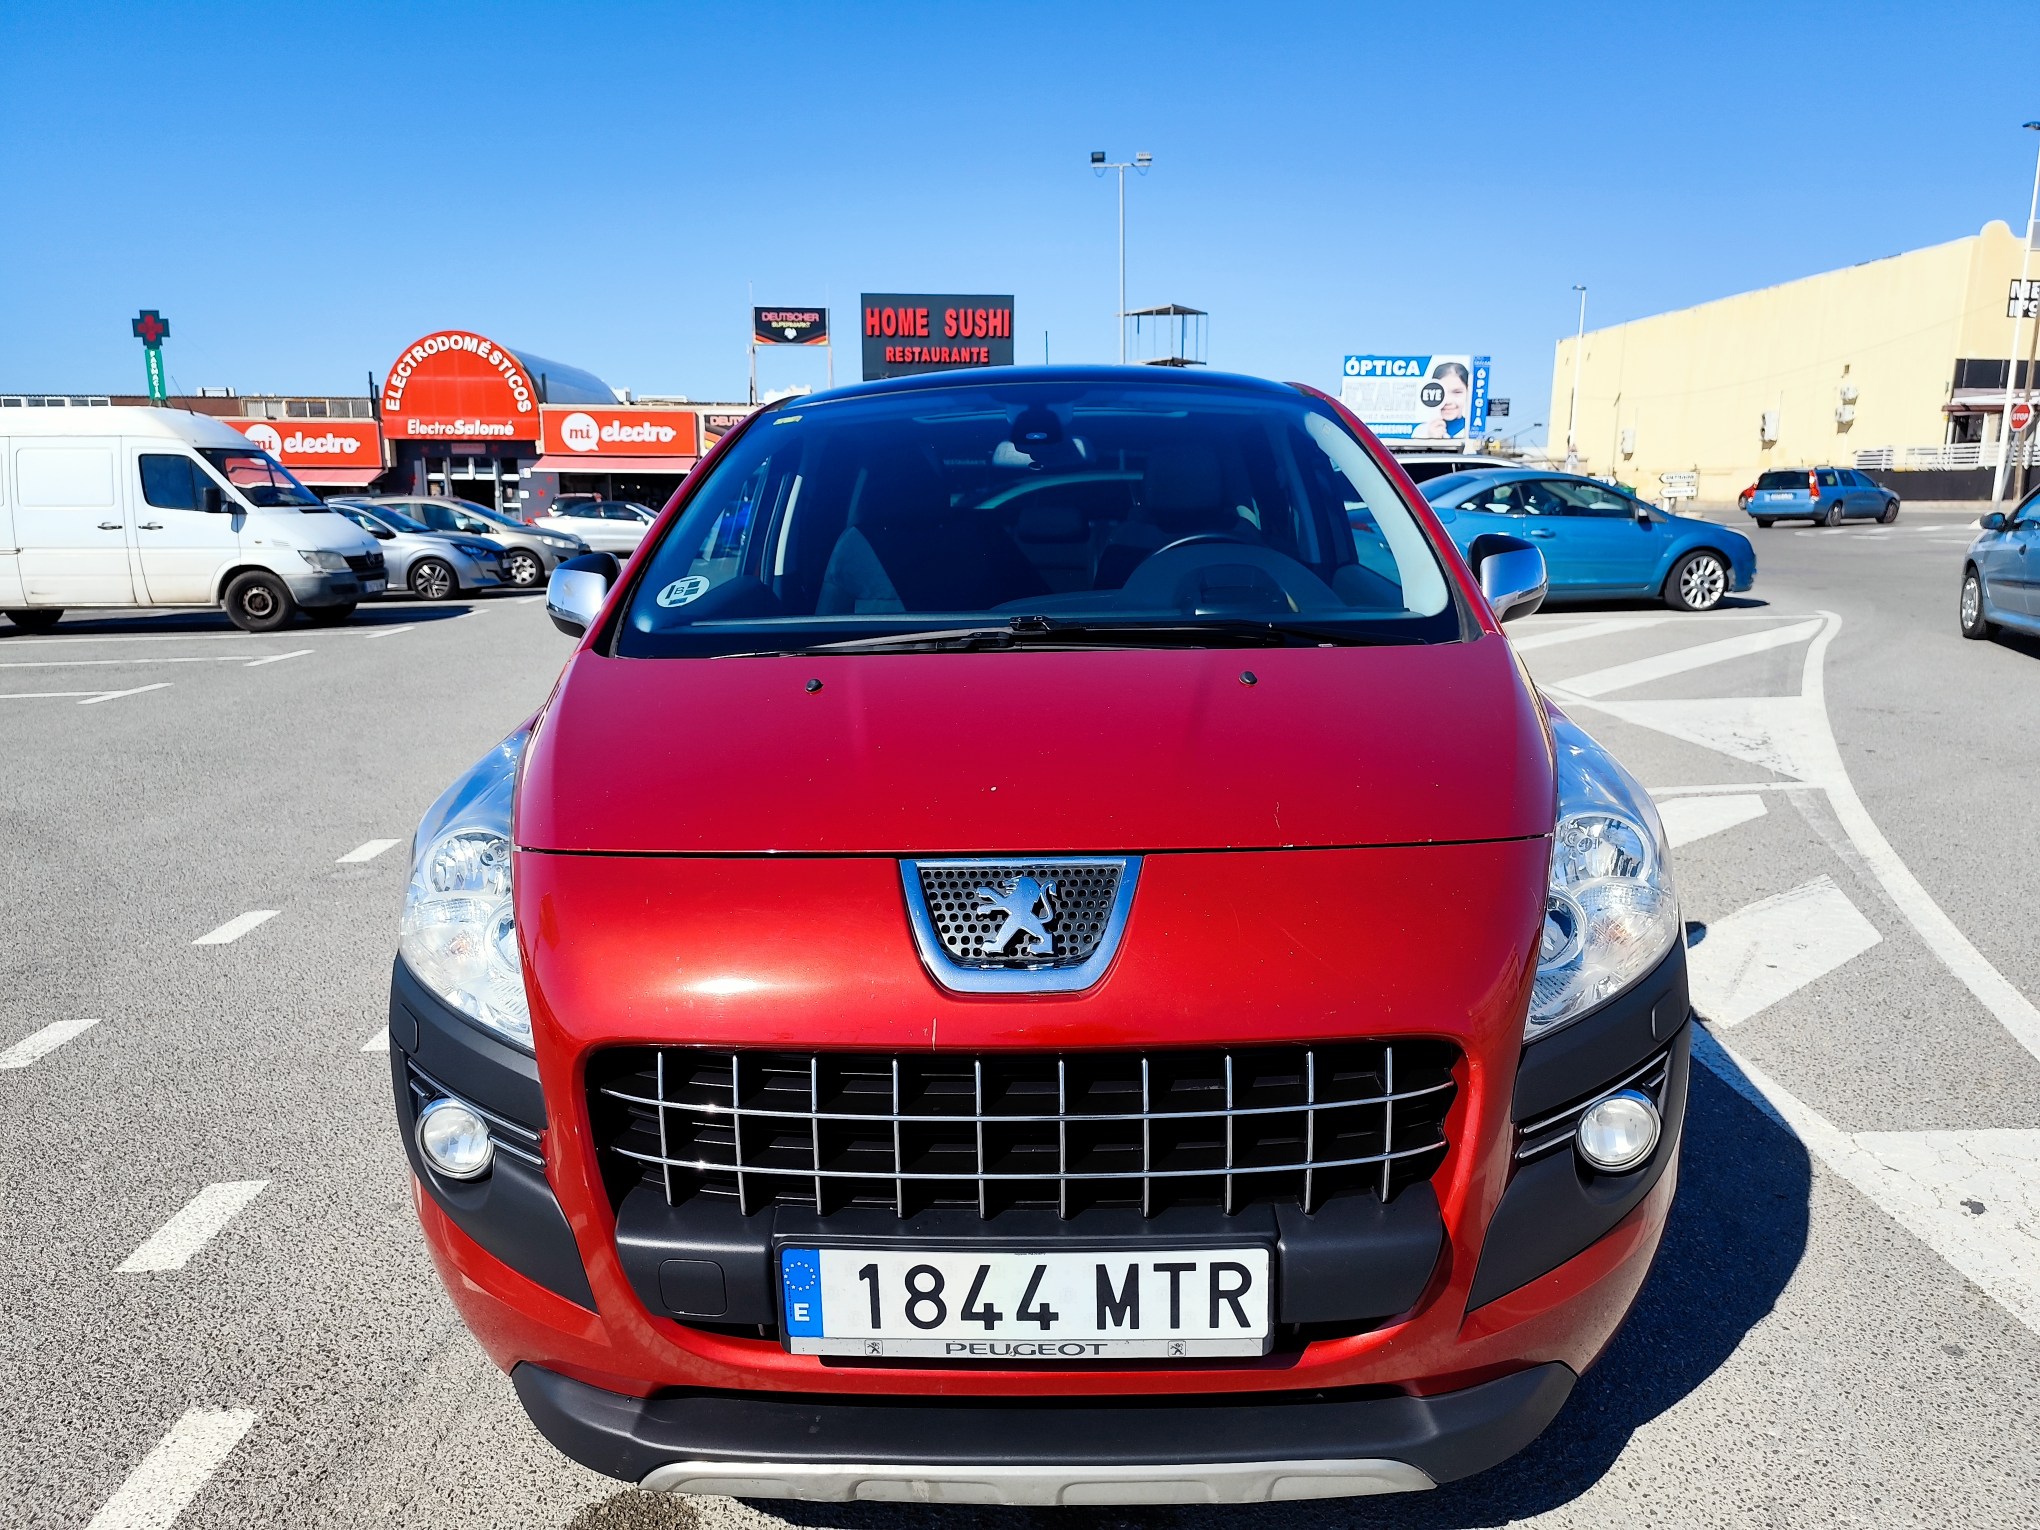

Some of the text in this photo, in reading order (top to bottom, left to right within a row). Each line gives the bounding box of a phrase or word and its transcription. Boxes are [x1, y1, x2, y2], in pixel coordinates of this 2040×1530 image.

[761, 312, 820, 322] DEUTSCHER
[865, 307, 1011, 338] HOME SUSHI
[885, 346, 990, 363] RESTAURANTE
[149, 350, 161, 398] FARMACIA
[385, 334, 532, 413] ELECTRODOMÉSTICOS
[1345, 356, 1421, 376] ÓPTICA
[1422, 388, 1442, 401] EYE
[710, 415, 745, 426] DEUT
[2012, 412, 2029, 421] STOP
[407, 418, 515, 436] ElectroSalomé
[570, 420, 677, 442] mi electro
[283, 431, 361, 454] electro
[674, 587, 684, 595] B
[858, 1263, 1059, 1331] 1844
[1096, 1262, 1252, 1331] MTR
[793, 1302, 811, 1322] E
[945, 1342, 1109, 1357] PEUGEOT
